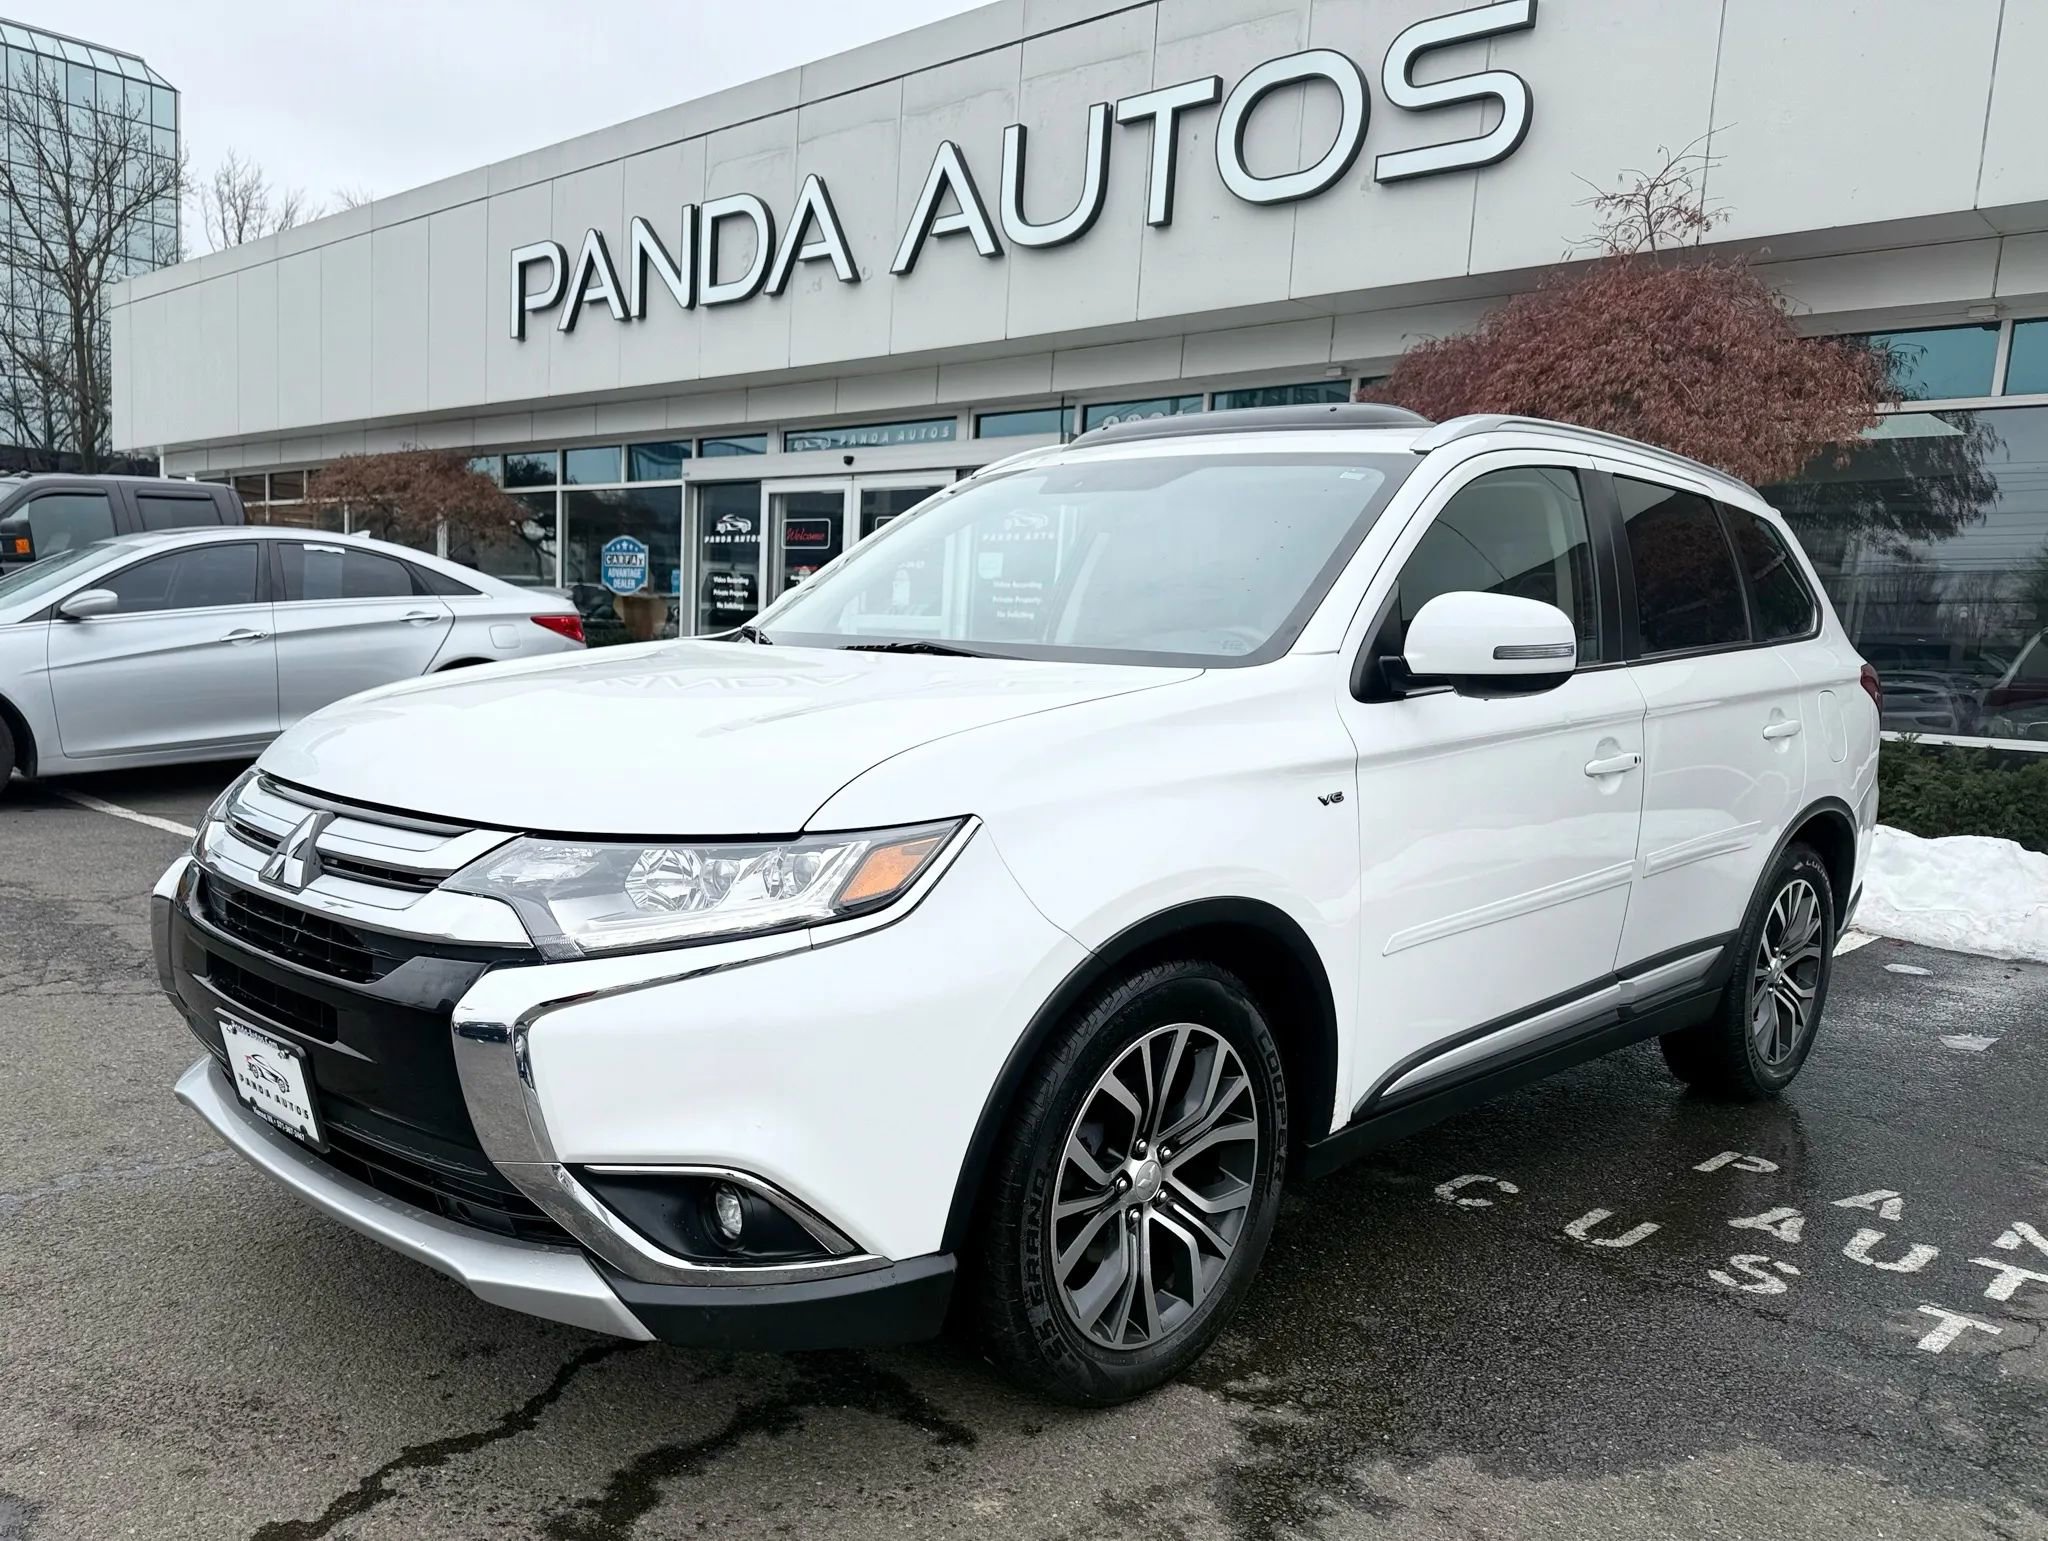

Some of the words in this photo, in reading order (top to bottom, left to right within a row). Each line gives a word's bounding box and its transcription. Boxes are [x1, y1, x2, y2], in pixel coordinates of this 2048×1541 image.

[510, 172, 861, 341] PANDA
[889, 0, 1538, 276] AUTOS
[839, 431, 890, 446] PANDA
[898, 426, 950, 441] AUTOS
[703, 535, 732, 544] PANDA
[786, 527, 826, 541] Welcome
[1024, 531, 1055, 540] AUTO
[606, 553, 645, 566] CARFAX
[607, 567, 643, 579] ADVANTAGE
[612, 578, 636, 589] DEALER
[713, 588, 729, 597] Private
[729, 589, 749, 599] Property
[716, 601, 724, 609] No
[1317, 791, 1345, 806] V6
[238, 1073, 272, 1099] PANDA
[274, 1094, 310, 1120] AUTOS
[1257, 1029, 1288, 1183] COOPER
